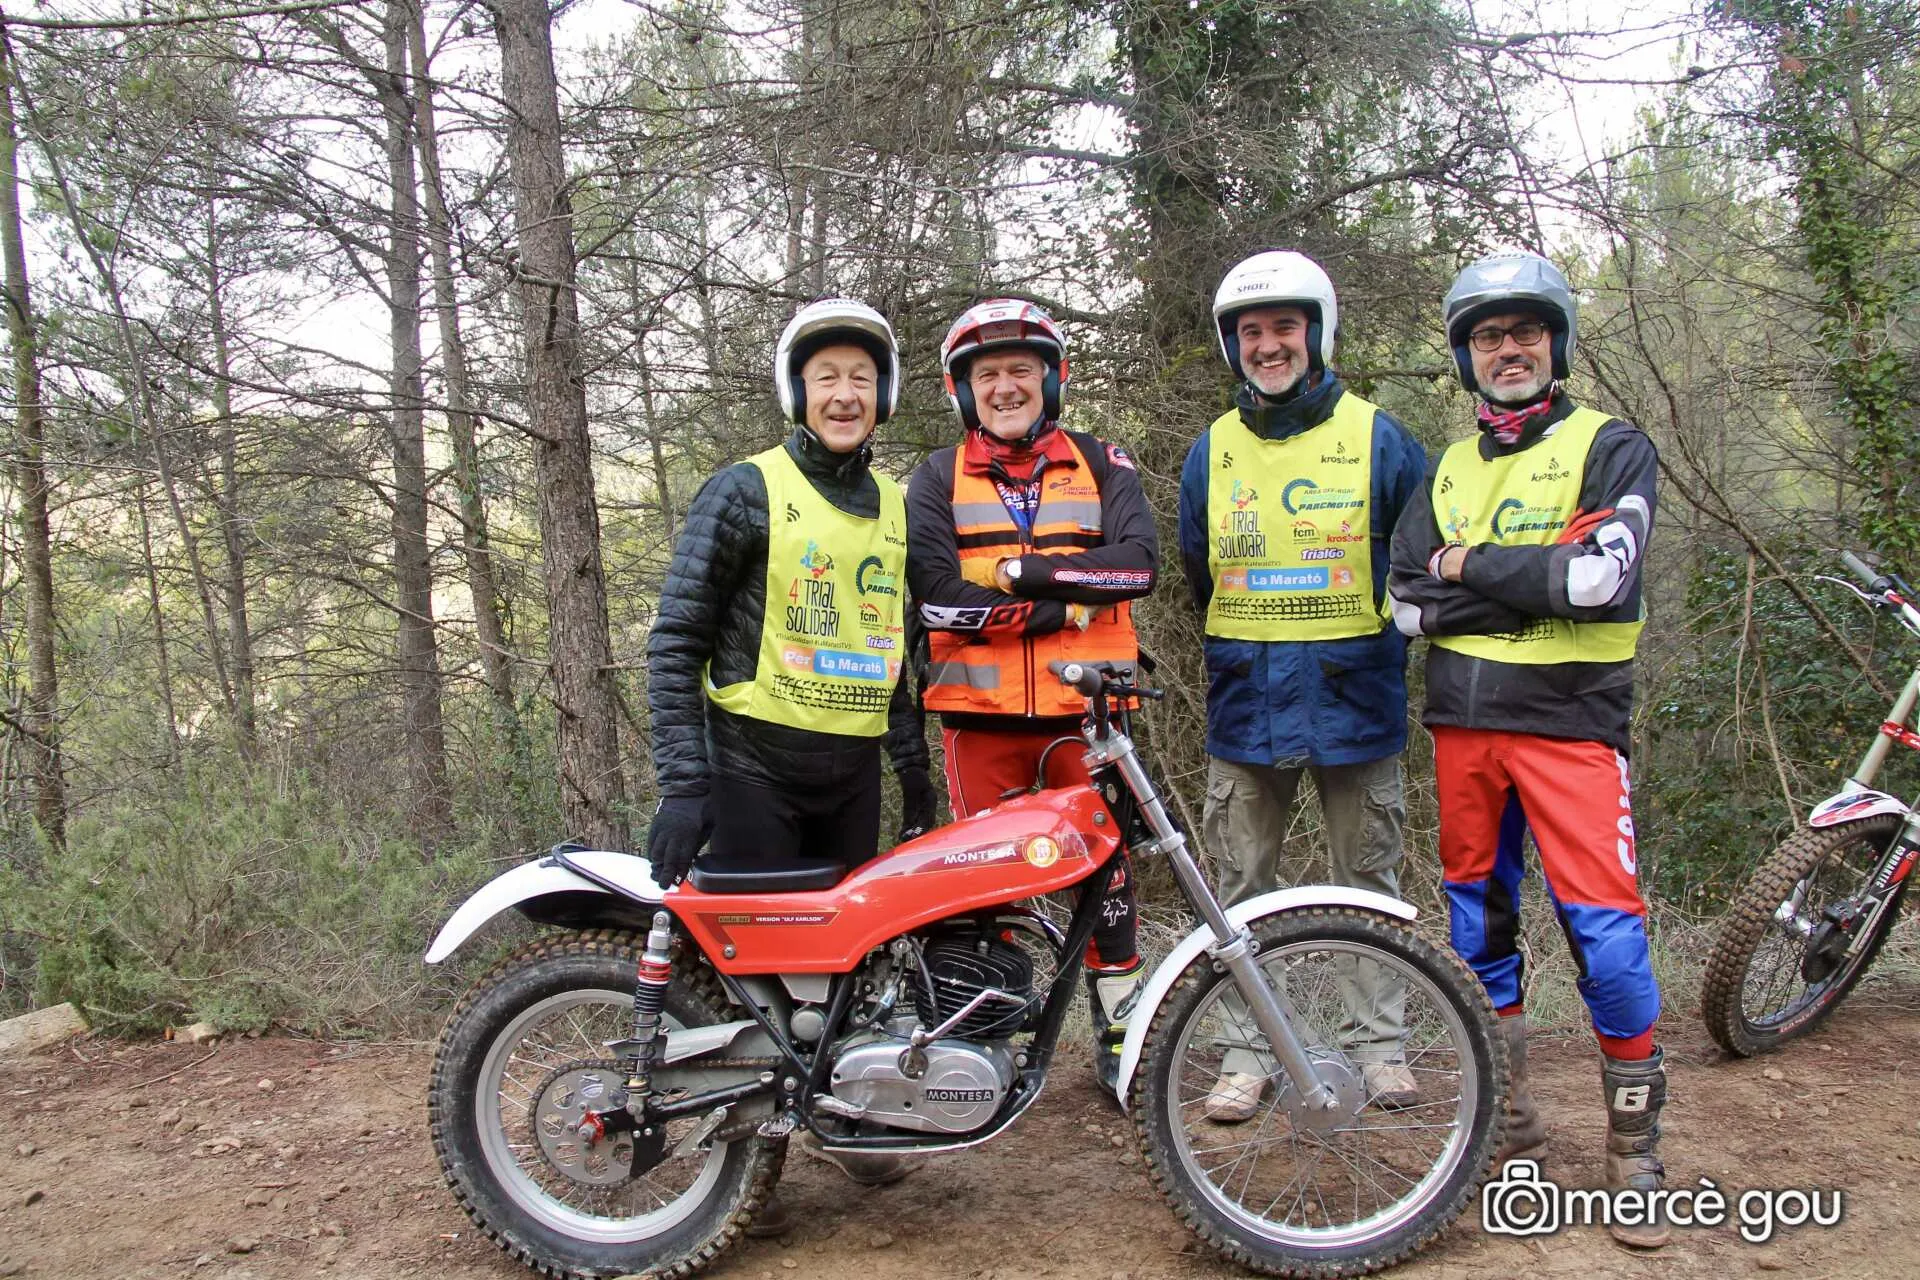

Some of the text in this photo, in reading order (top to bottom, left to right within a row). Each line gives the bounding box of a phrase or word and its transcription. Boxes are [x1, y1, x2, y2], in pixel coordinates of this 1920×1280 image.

[1237, 282, 1270, 293] SHOEI
[1320, 455, 1360, 465] krosbee
[1298, 500, 1365, 511] PARCMOTOR
[1293, 528, 1315, 538] fcm
[1327, 533, 1364, 543] krosbee
[1301, 548, 1345, 561] TrialGo
[1252, 575, 1267, 585] La
[1270, 573, 1322, 585] Marató
[1340, 571, 1351, 583] 3
[860, 611, 878, 623] fcm
[784, 651, 882, 674] Per La Marató
[943, 843, 1017, 865] MONTESA
[755, 915, 780, 923] VERSION
[926, 1089, 994, 1101] MONTESA
